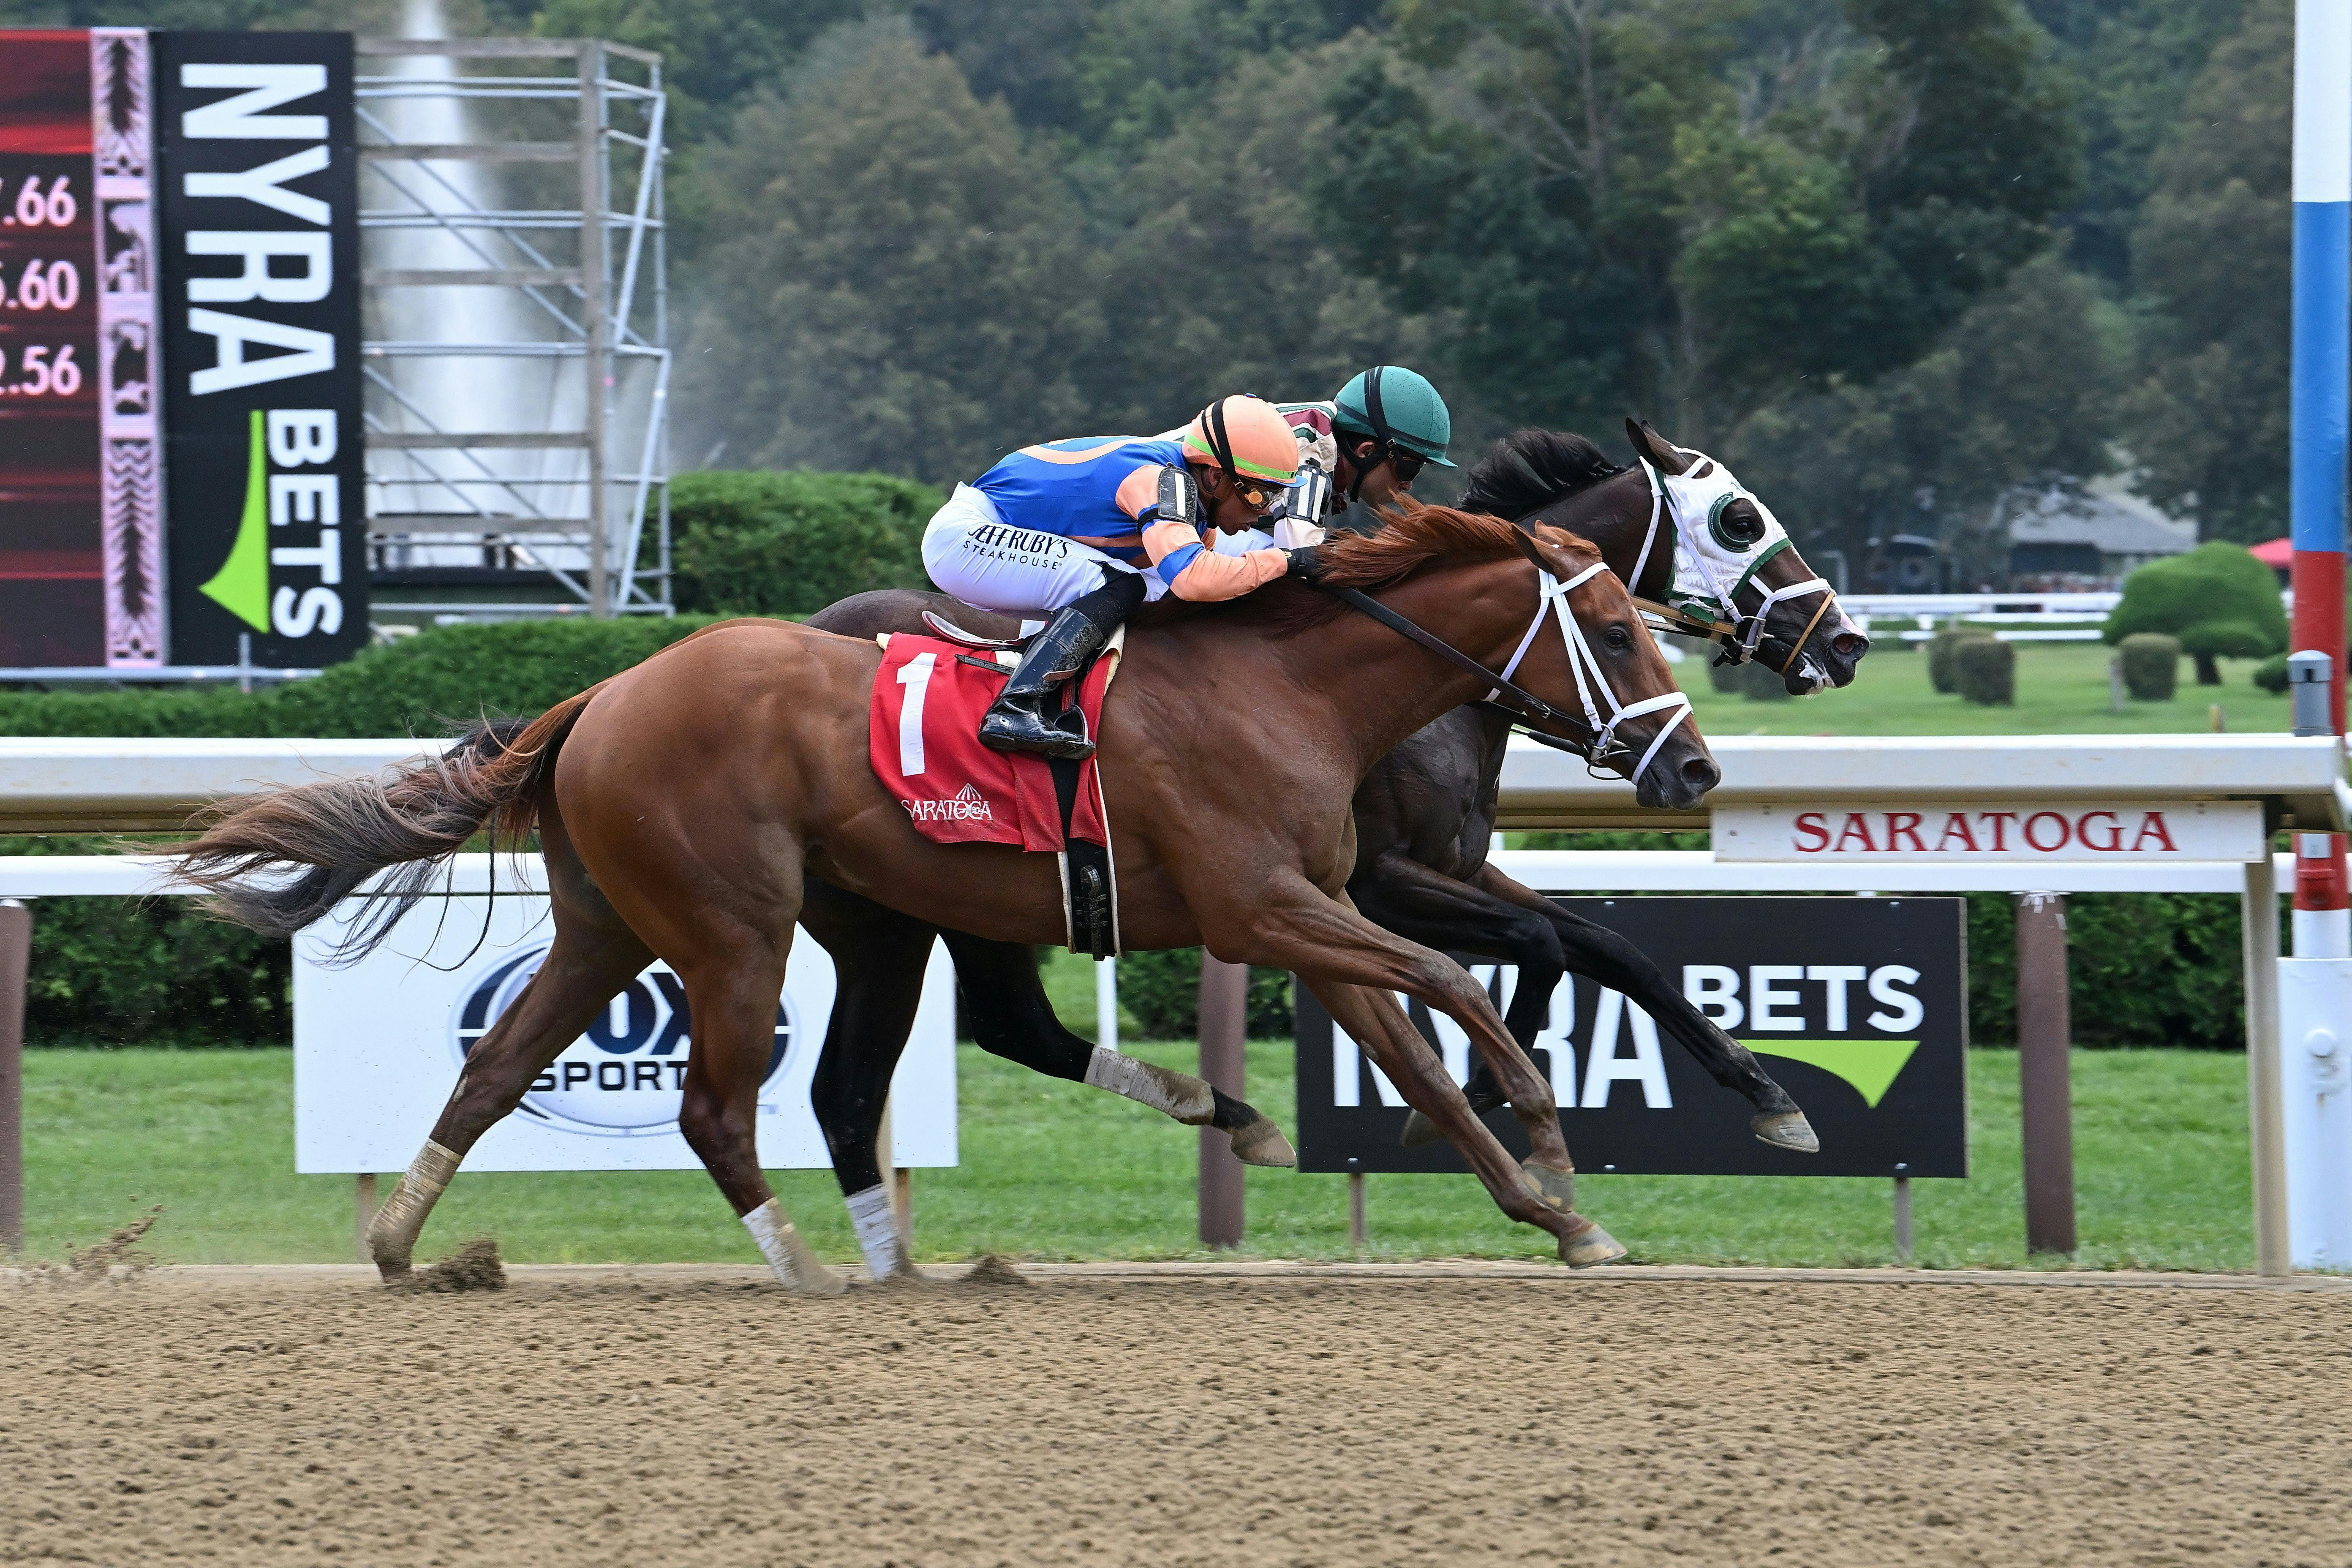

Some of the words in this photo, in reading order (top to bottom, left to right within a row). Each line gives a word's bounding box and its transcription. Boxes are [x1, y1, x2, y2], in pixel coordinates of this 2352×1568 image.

[0, 174, 77, 227] .66
[180, 63, 335, 395] NYRA
[0, 259, 80, 310] .60
[0, 344, 82, 396] .56
[268, 409, 343, 637] BETS
[963, 540, 1058, 570] STEAKHOUSE
[896, 652, 937, 776] 1
[901, 800, 994, 821] SARATOGA
[1792, 811, 2179, 852] SARATOGA
[1682, 964, 1924, 1033] BETS
[531, 1061, 688, 1091] SPORT
